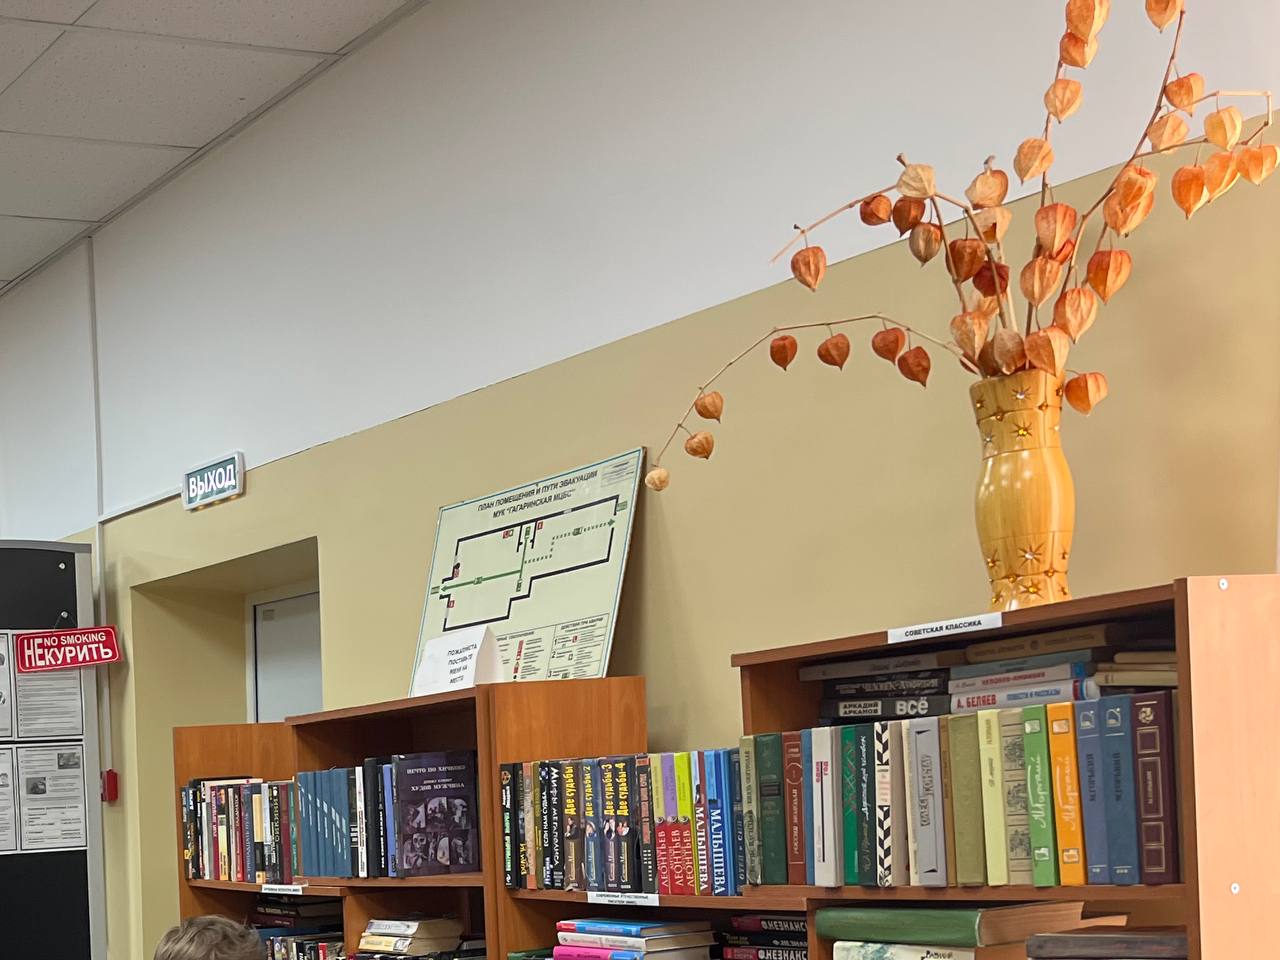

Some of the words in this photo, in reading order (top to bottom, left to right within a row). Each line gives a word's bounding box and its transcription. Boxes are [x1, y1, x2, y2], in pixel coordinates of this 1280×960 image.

[189, 464, 235, 497] ВЫХОД
[905, 625, 944, 637] СОВЕТСКАЯ
[945, 619, 982, 631] КЛАССИКА
[44, 637, 58, 646] NO
[61, 632, 106, 645] SMOKING
[44, 643, 113, 665] КУРИТЬ
[966, 694, 997, 707] БЕЛЯЕВ
[563, 766, 576, 799] судьбы
[583, 766, 594, 801] судьбы-2
[602, 764, 614, 801] судьбы-3
[615, 762, 629, 800] судьбы-4
[565, 801, 576, 815] Две
[585, 802, 594, 817] Две
[604, 802, 615, 815] Две
[617, 802, 629, 816] Две
[696, 807, 708, 890] МАЛЫШЕВА
[710, 809, 725, 894] МАЛЫШЕВА
[758, 950, 806, 960] Ф.НЕЗНАНС
